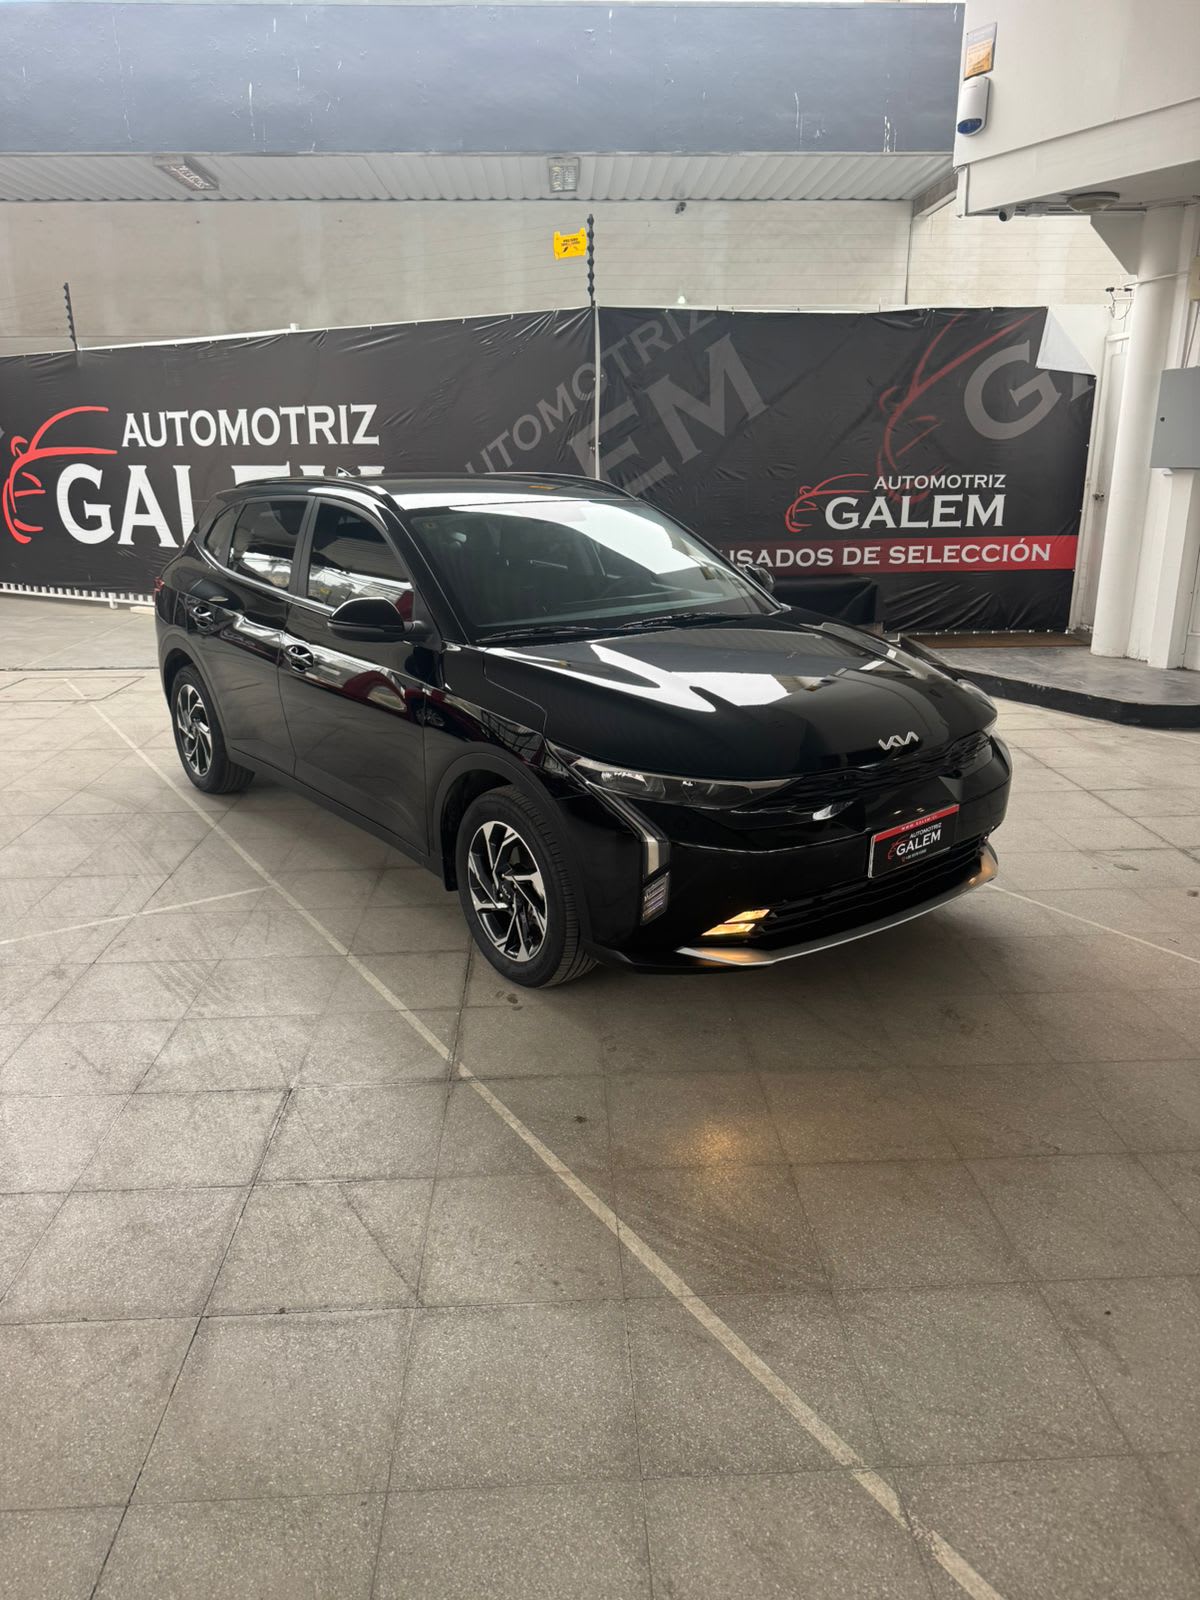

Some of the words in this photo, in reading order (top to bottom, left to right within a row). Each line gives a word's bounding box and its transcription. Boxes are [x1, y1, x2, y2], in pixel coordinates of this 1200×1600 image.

[122, 403, 380, 448] AUTOMOTRIZ
[874, 474, 1006, 490] AUTOMOTRIZ
[56, 460, 385, 548] GAL
[825, 494, 1006, 530] GALEM
[842, 547, 881, 566] DE
[889, 538, 1051, 565] SELECCIÓN
[896, 829, 942, 856] GALEM
[909, 822, 942, 839] AUTOMOTRIZ
